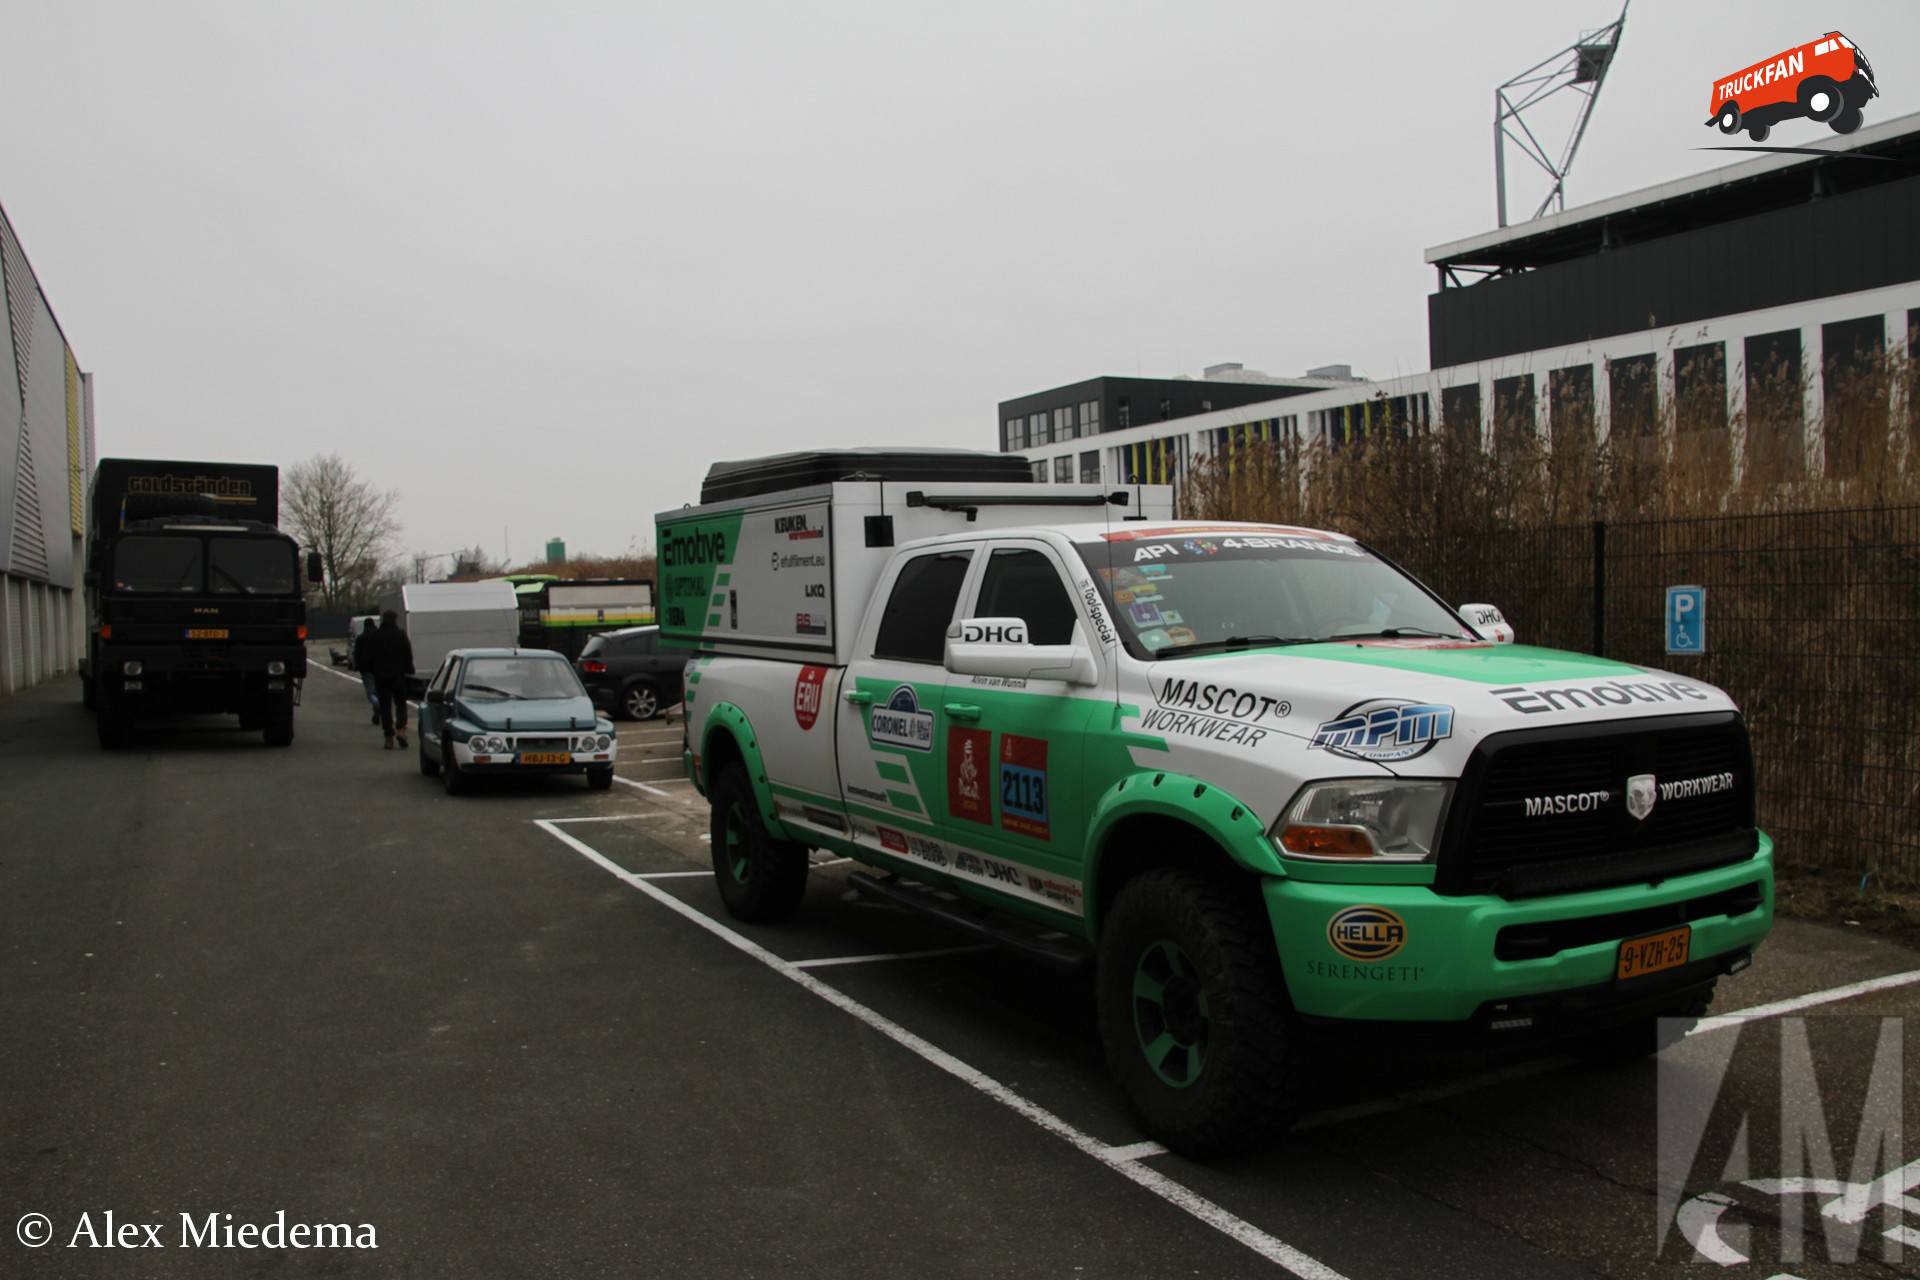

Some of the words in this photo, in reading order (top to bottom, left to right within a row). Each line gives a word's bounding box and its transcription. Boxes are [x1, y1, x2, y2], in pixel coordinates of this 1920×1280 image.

[662, 527, 725, 567] Emotive
[1133, 543, 1179, 562] API
[804, 584, 825, 599] LKQ
[1085, 587, 1115, 645] Toolspecial
[1675, 593, 1695, 623] P
[964, 626, 1023, 643] DHG
[1489, 681, 1708, 714] Emotive
[872, 714, 908, 738] CORONEL
[1140, 707, 1268, 748] WORKWEAR
[1002, 769, 1044, 816] 2113
[1659, 771, 1734, 802] WORKWEAR
[1336, 924, 1404, 943] HELLA
[1623, 933, 1684, 974] 9-VZH-25
